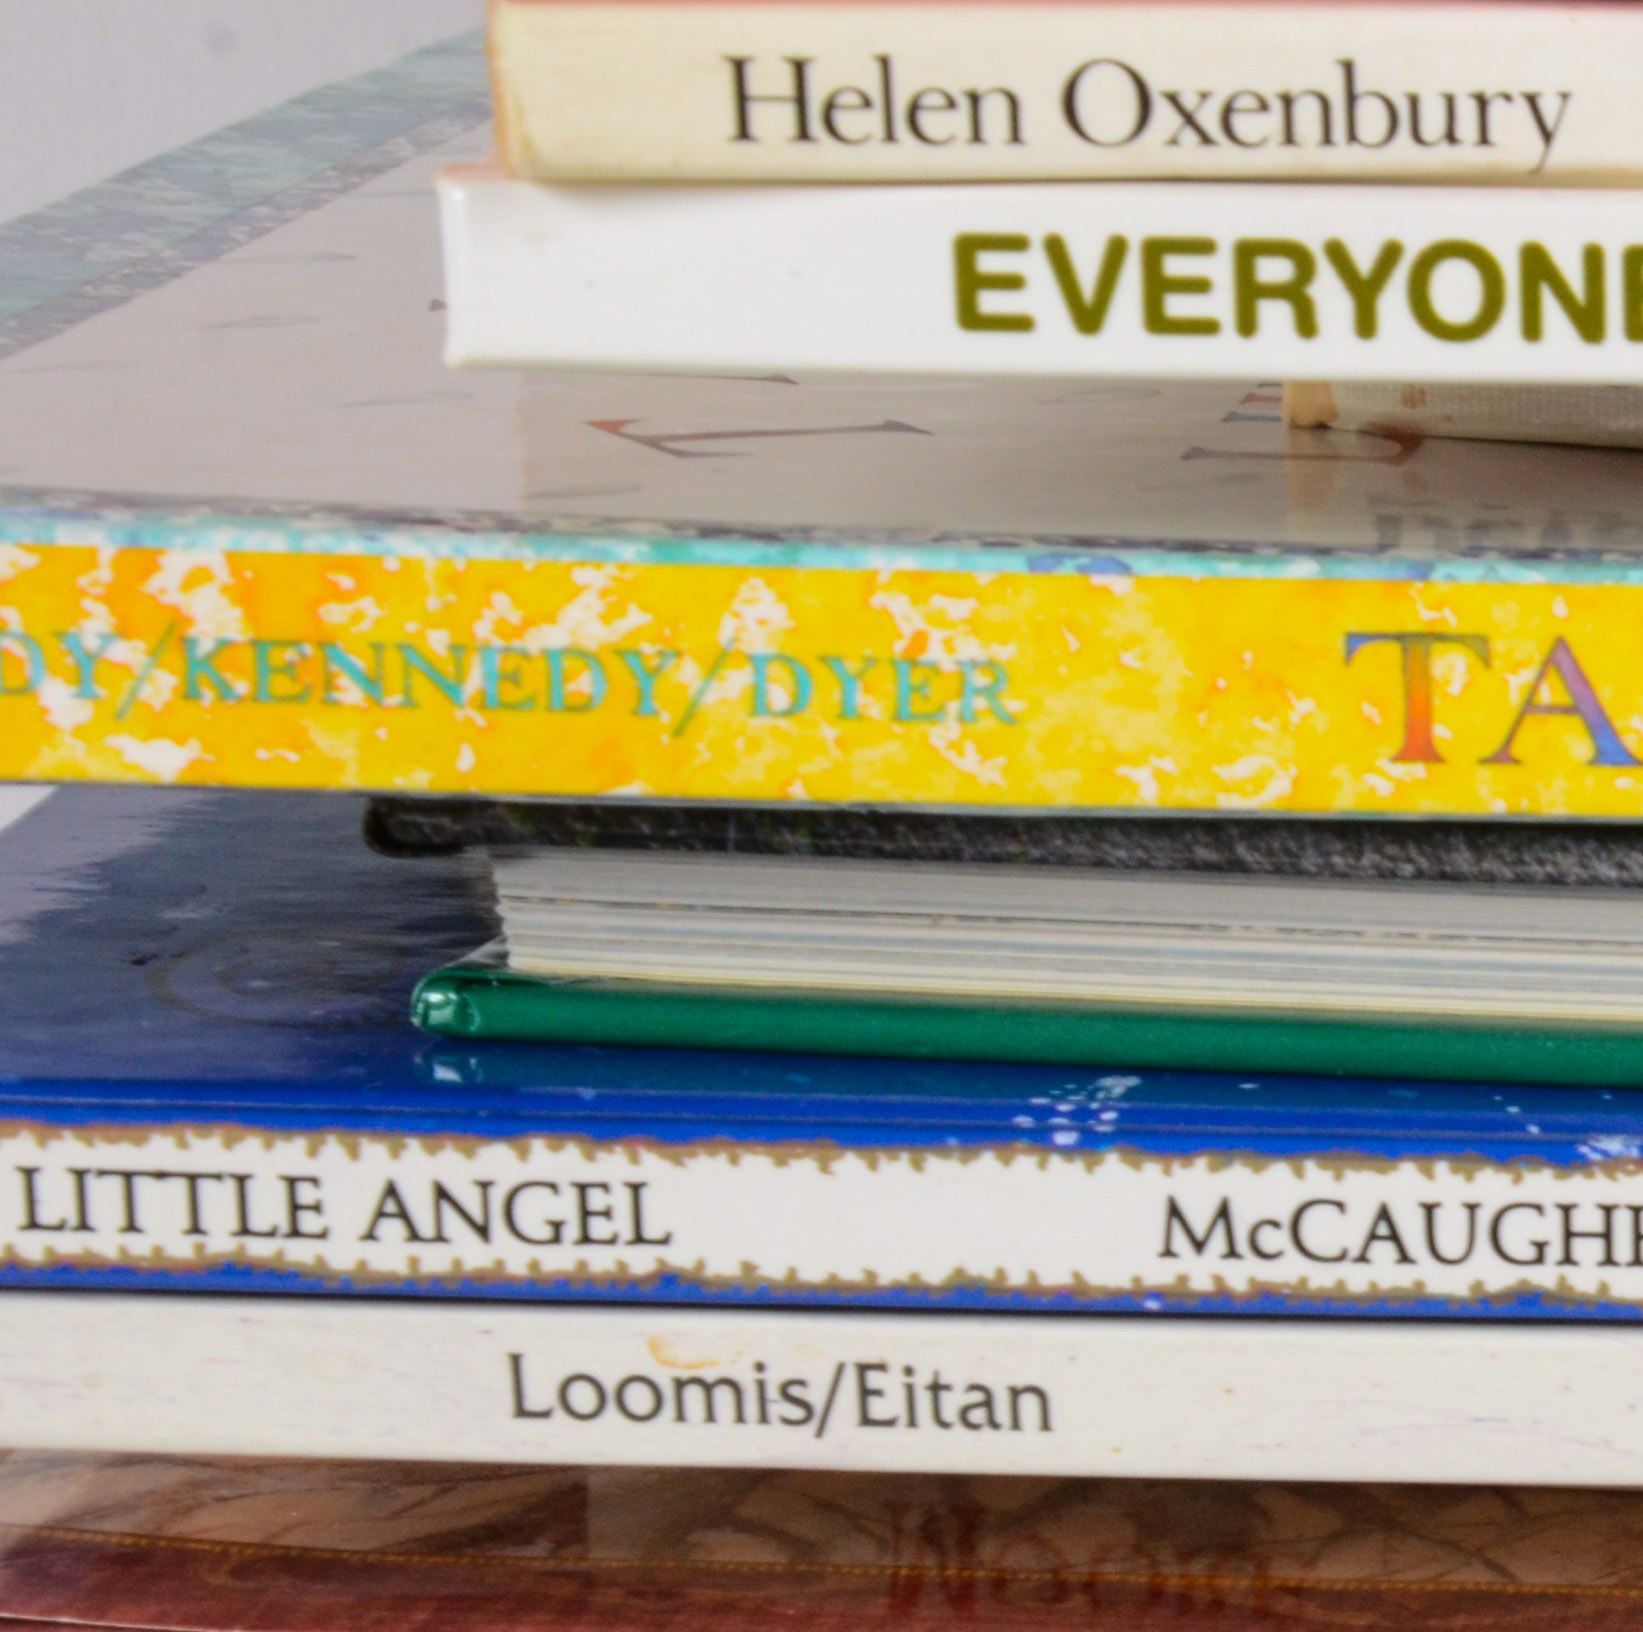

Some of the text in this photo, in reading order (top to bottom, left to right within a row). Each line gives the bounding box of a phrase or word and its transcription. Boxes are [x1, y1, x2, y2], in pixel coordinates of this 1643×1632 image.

[723, 54, 1574, 176] Helen Oxenbury
[15, 1166, 673, 1250] LITTLE ANGEL
[506, 1352, 1054, 1440] Loomis/Eitan
